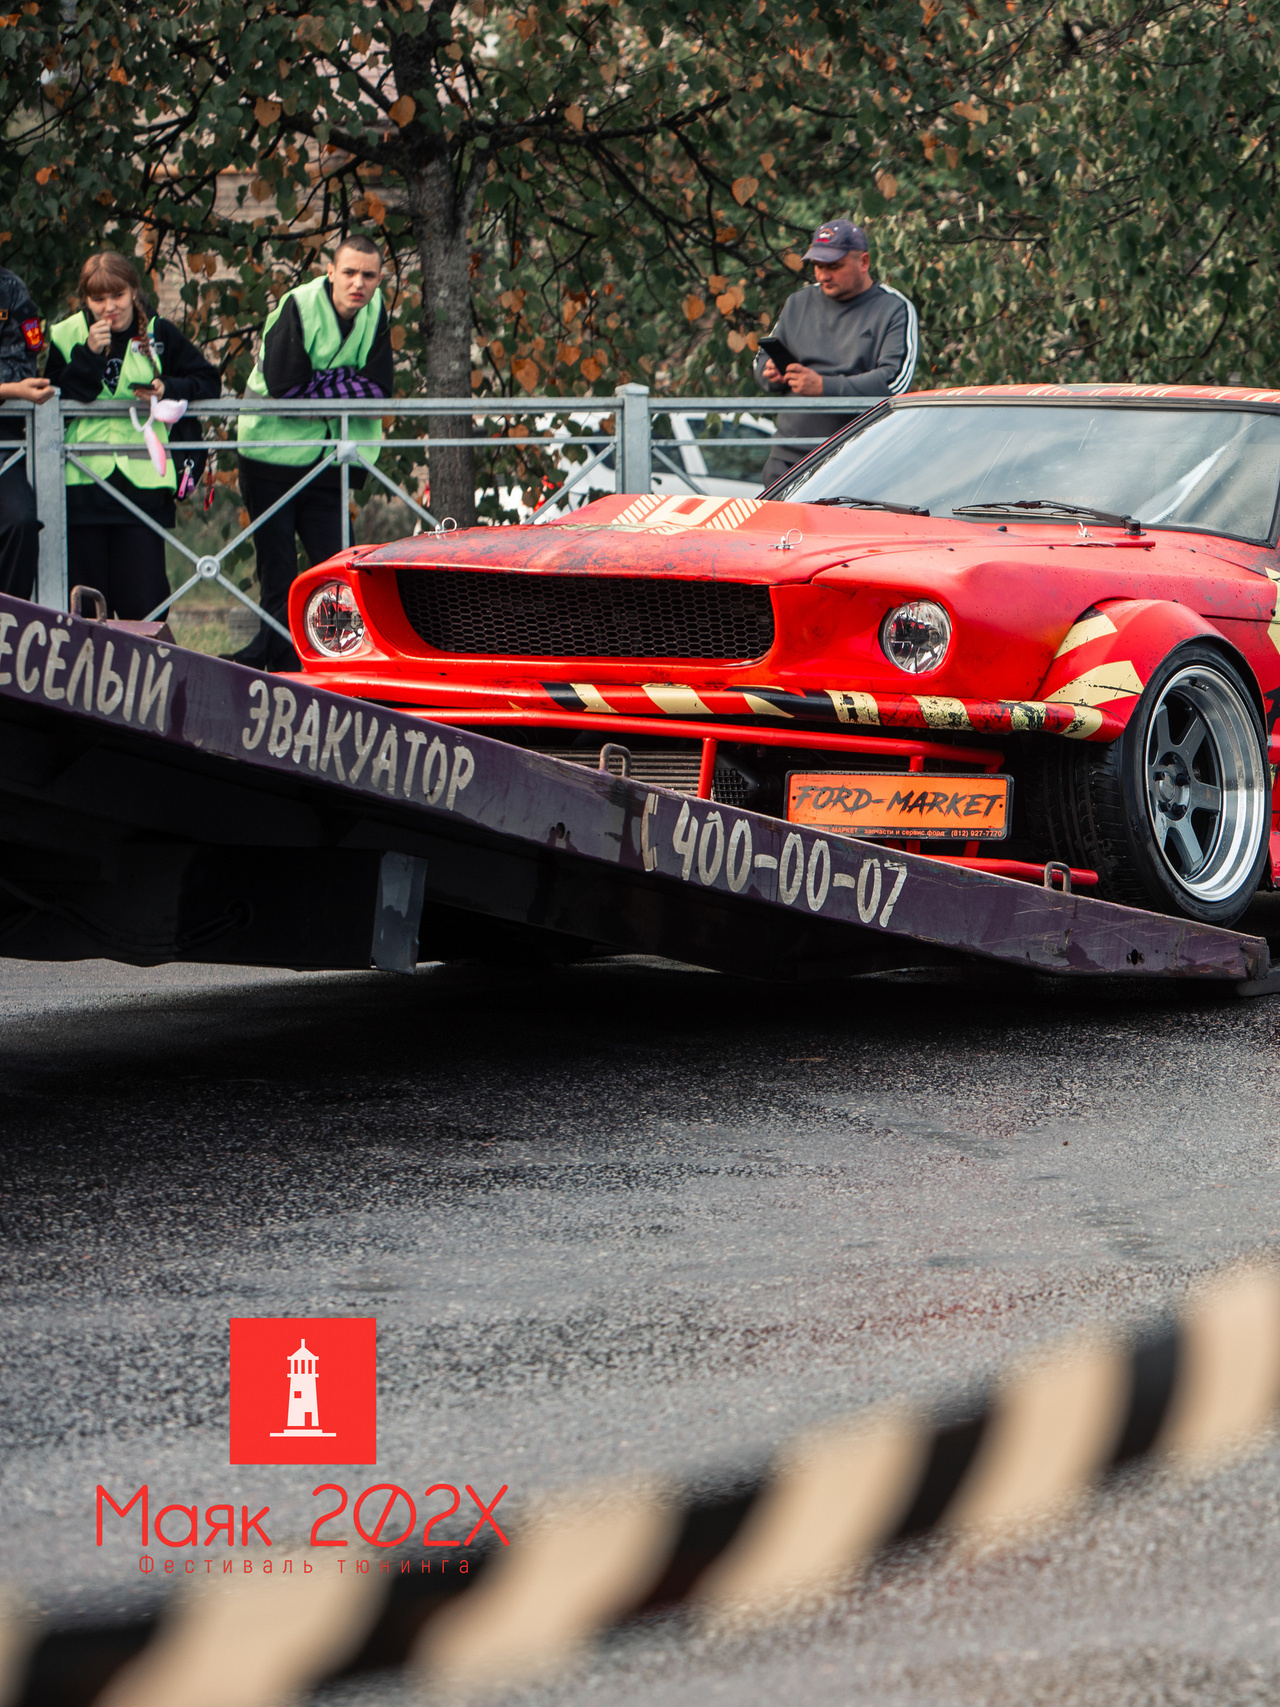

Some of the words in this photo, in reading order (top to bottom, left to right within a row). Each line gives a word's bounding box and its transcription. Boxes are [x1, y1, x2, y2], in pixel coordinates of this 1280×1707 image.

[242, 679, 475, 811] ЭВАКУАТОР
[672, 800, 908, 928] 400-00-07
[794, 785, 1005, 818] FORD-MARKET
[901, 829, 925, 837] сервис
[926, 828, 945, 838] форд
[951, 829, 969, 837] (812)
[970, 829, 1003, 837] 927-7770
